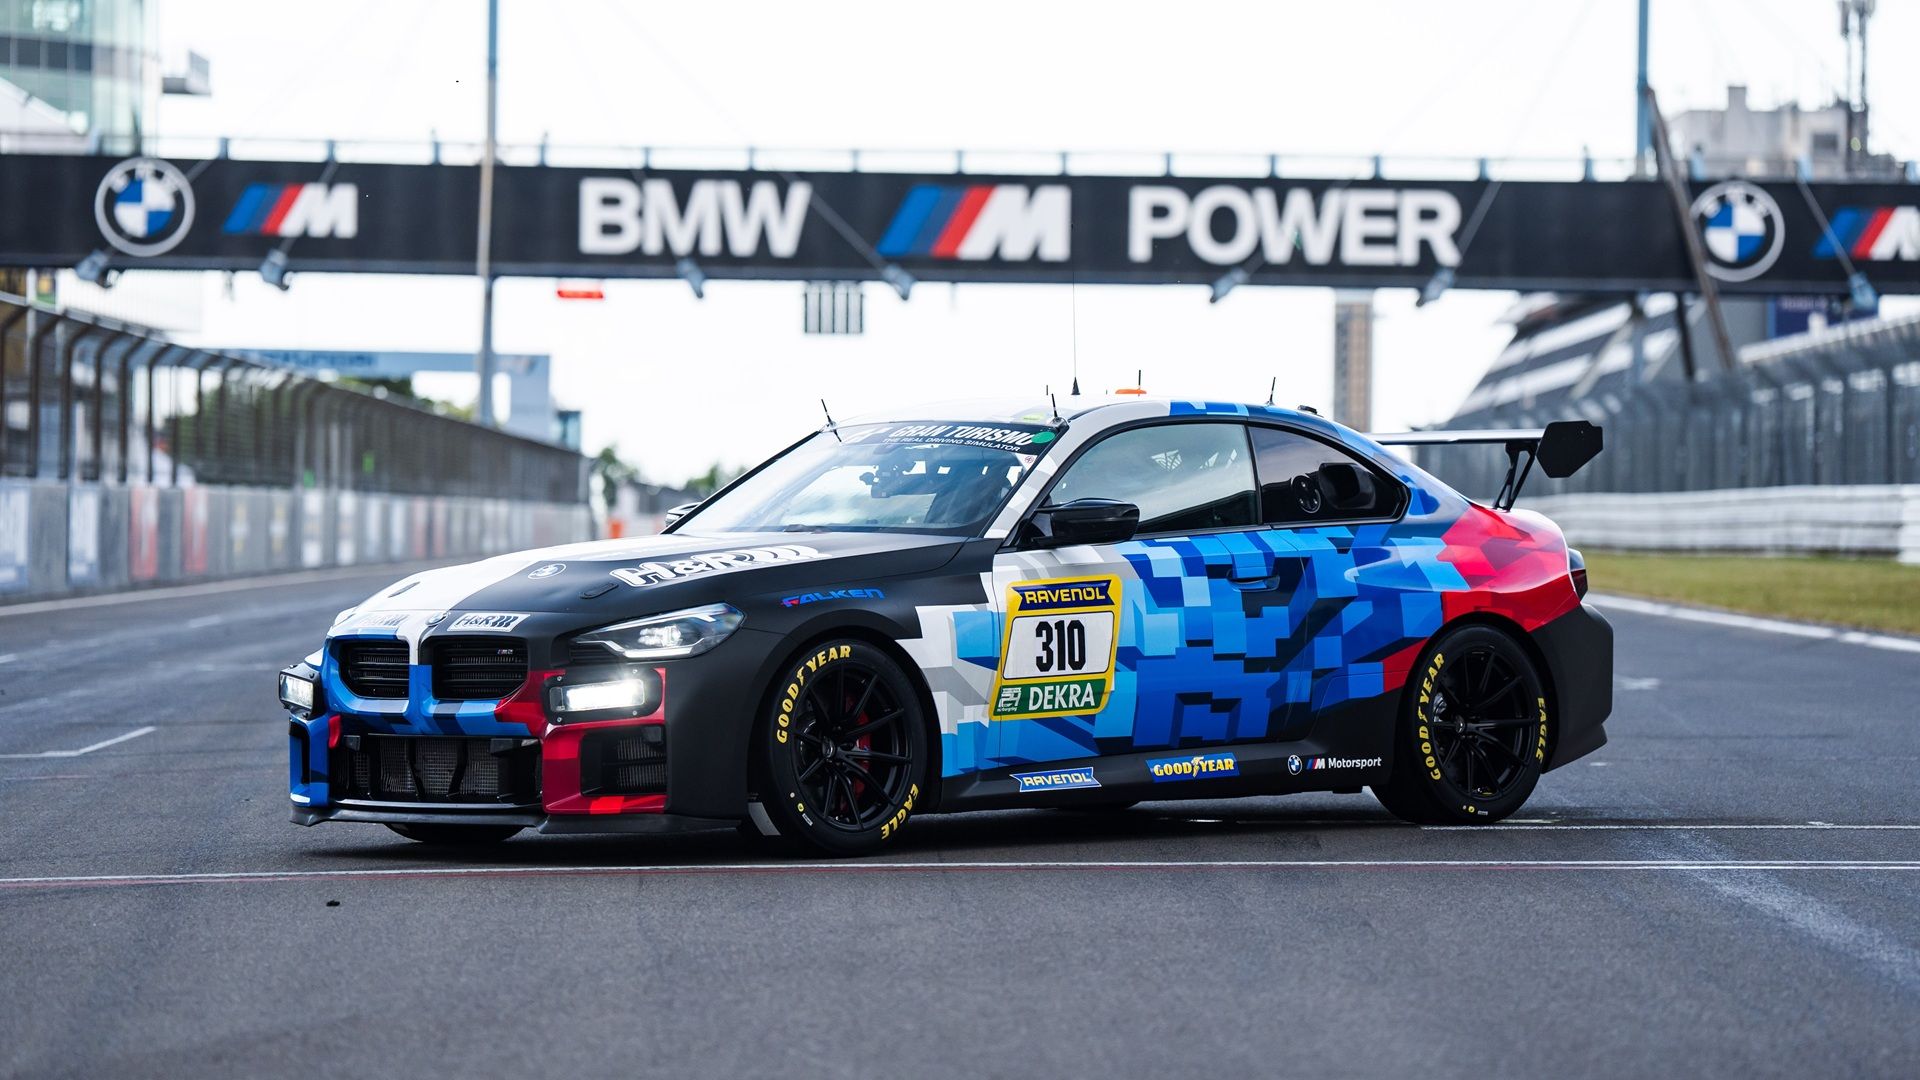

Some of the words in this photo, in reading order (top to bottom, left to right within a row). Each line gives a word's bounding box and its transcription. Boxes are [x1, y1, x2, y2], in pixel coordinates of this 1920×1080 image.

[577, 177, 813, 257] BMW
[1127, 186, 1462, 267] POWER
[888, 425, 953, 438] GRAN
[944, 426, 1036, 446] TURISMO
[964, 440, 1021, 452] SIMULATOR
[781, 588, 885, 608] FALKEN
[1024, 587, 1106, 604] RAVENOL
[454, 615, 496, 628] H&R
[1035, 619, 1087, 672] 310
[776, 645, 851, 744] GOODYEAR
[1028, 682, 1096, 711] DEKRA
[1417, 653, 1445, 781] GOODYEAR
[1535, 697, 1547, 765] EAGLE
[1153, 757, 1235, 777] GOODYEAR
[1328, 757, 1382, 769] Motorsport
[1022, 773, 1092, 787] RAVENOL
[881, 783, 919, 840] EAGLE
